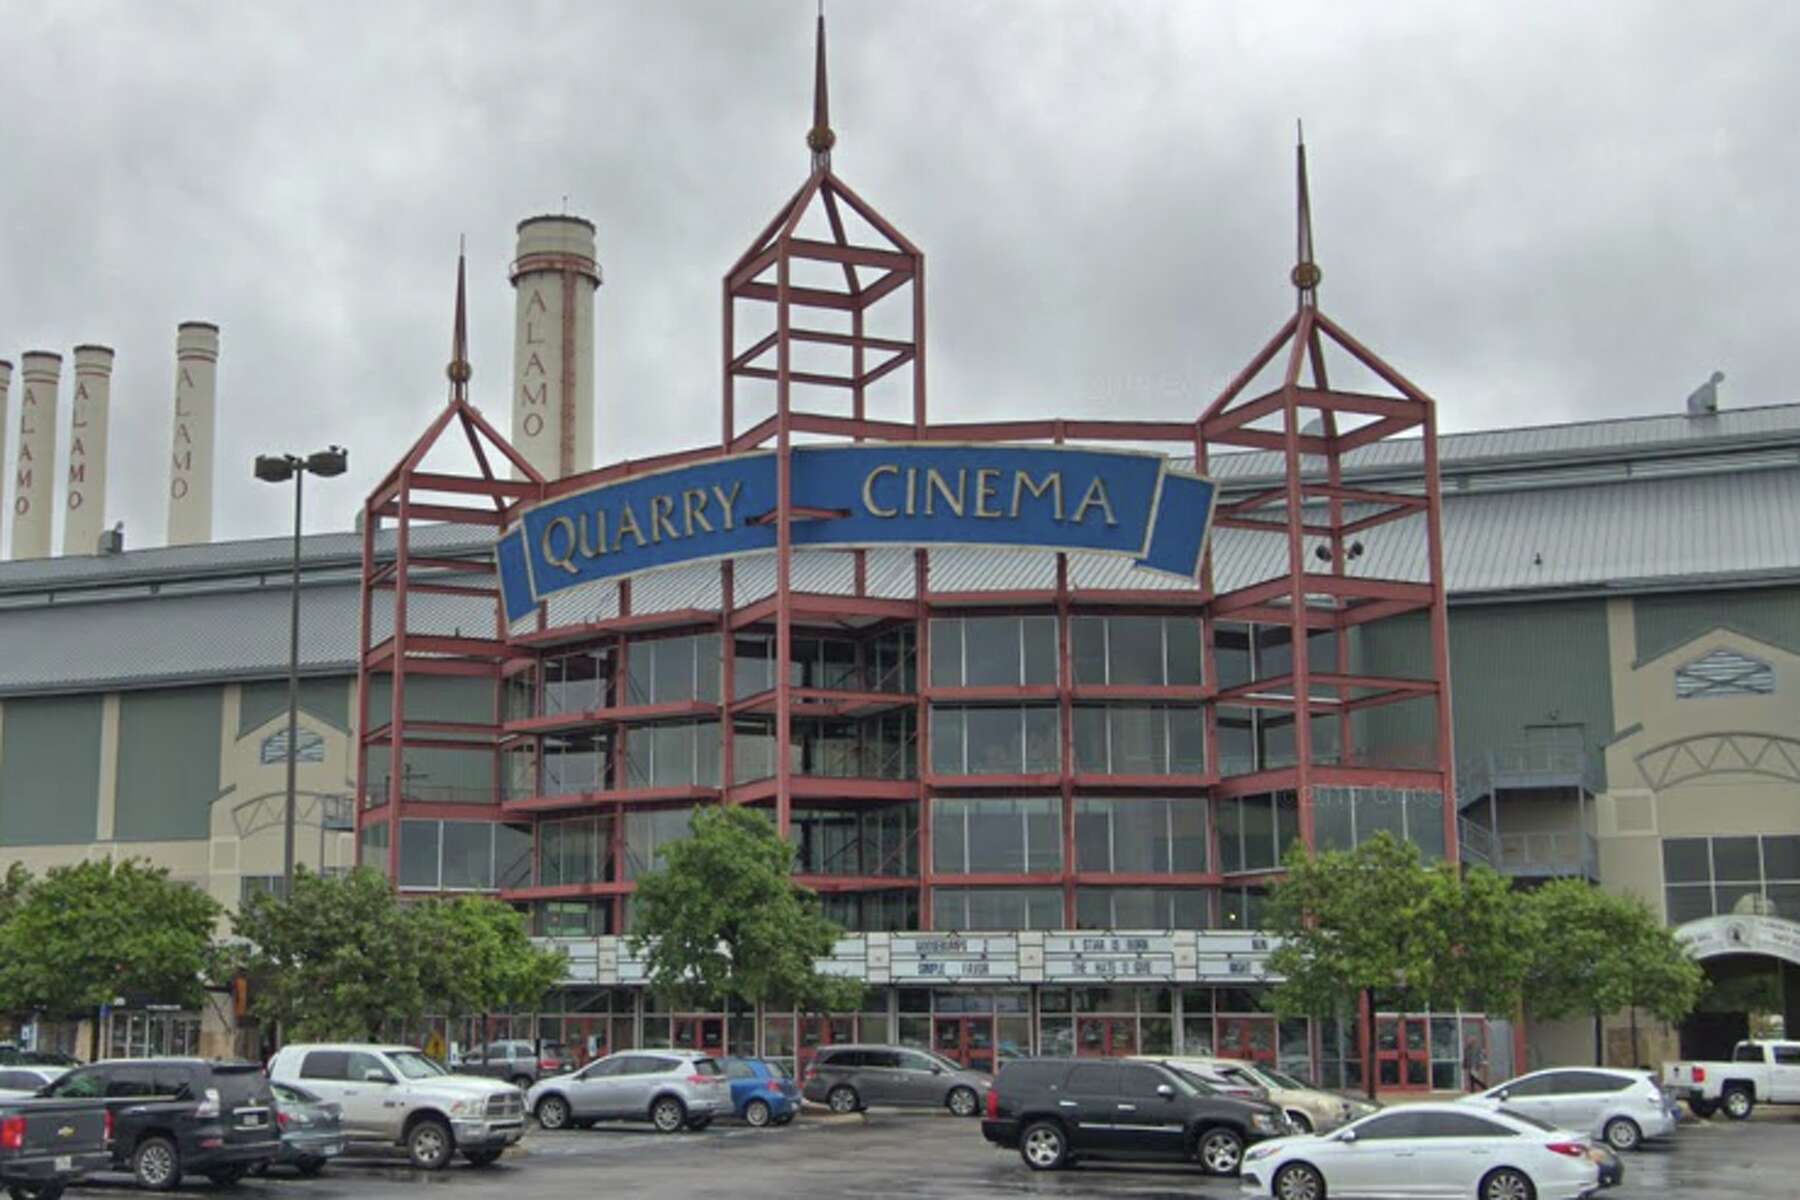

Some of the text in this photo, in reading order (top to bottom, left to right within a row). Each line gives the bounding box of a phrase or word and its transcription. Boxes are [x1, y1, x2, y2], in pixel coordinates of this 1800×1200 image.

[521, 289, 548, 438] ALAMO
[14, 387, 37, 516] ALAMO
[68, 382, 89, 510] ALAMO
[171, 367, 194, 500] ALAMO
[542, 464, 1118, 575] QUARRY CINEMA
